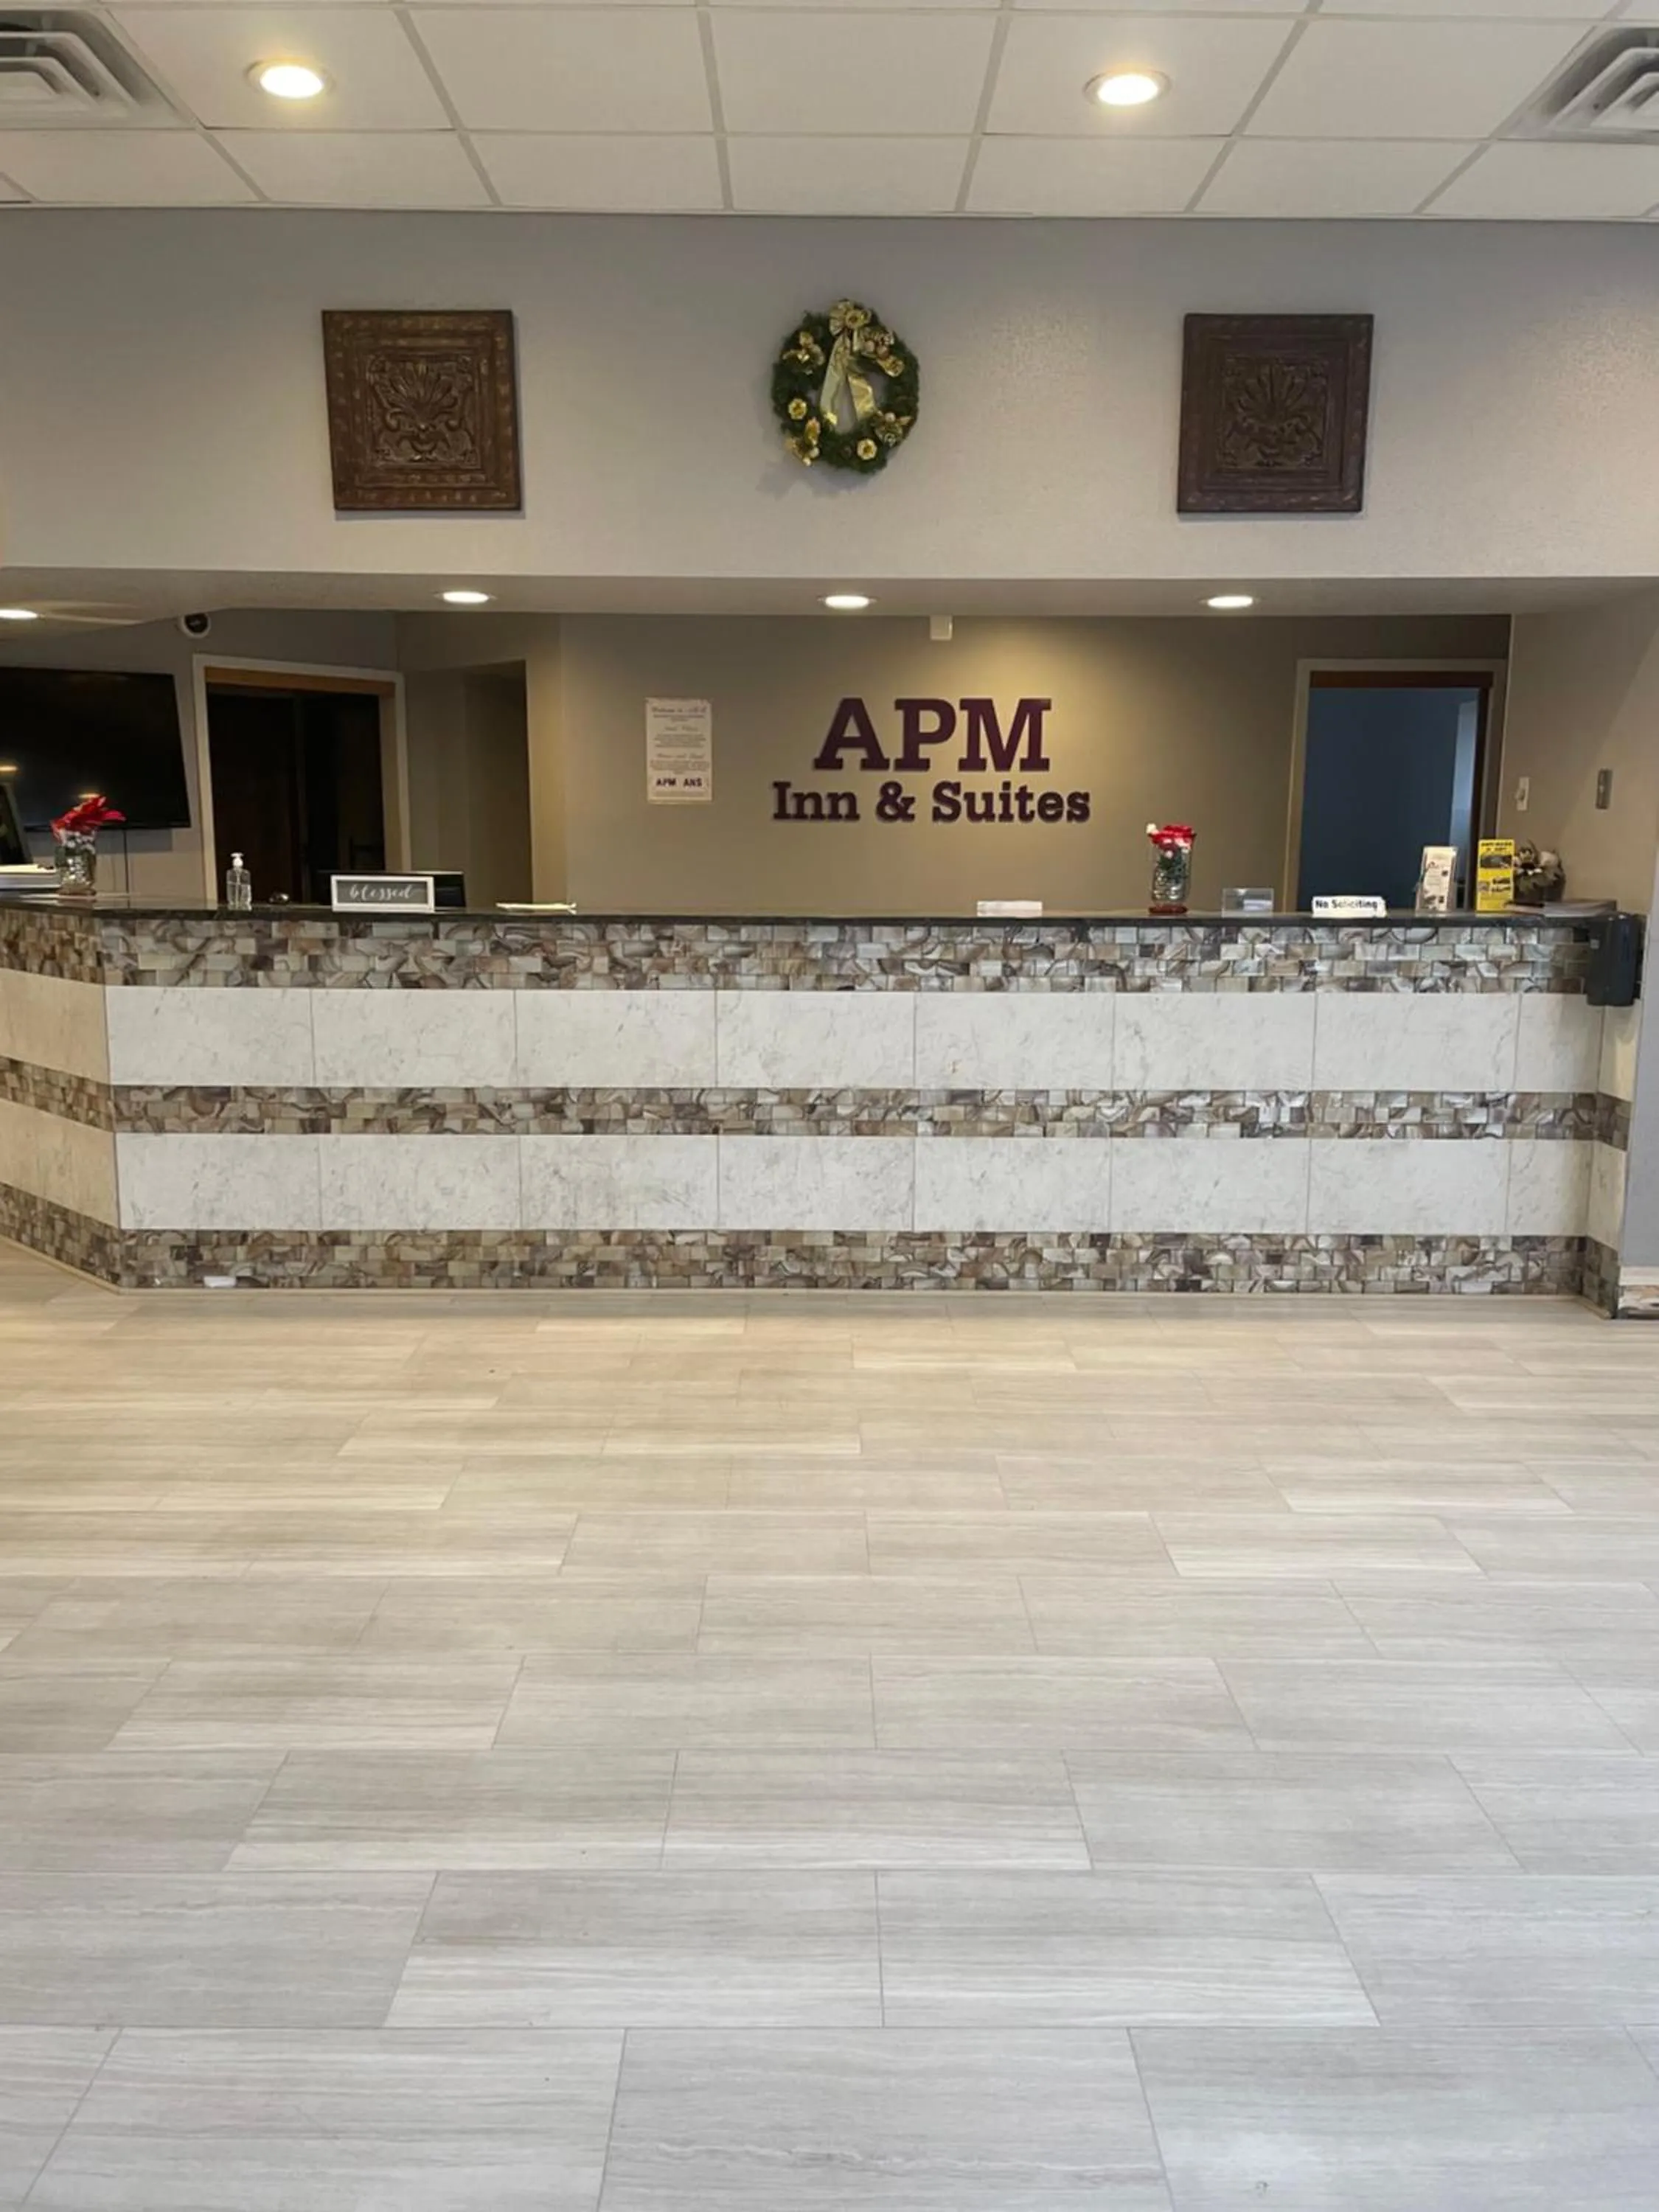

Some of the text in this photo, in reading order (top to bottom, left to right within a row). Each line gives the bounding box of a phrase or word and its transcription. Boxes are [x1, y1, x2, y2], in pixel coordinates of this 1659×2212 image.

[813, 698, 1051, 772] APM
[772, 781, 1091, 823] Inn & Suites
[349, 884, 413, 901] blessed
[1315, 900, 1378, 911] No Soliciting
